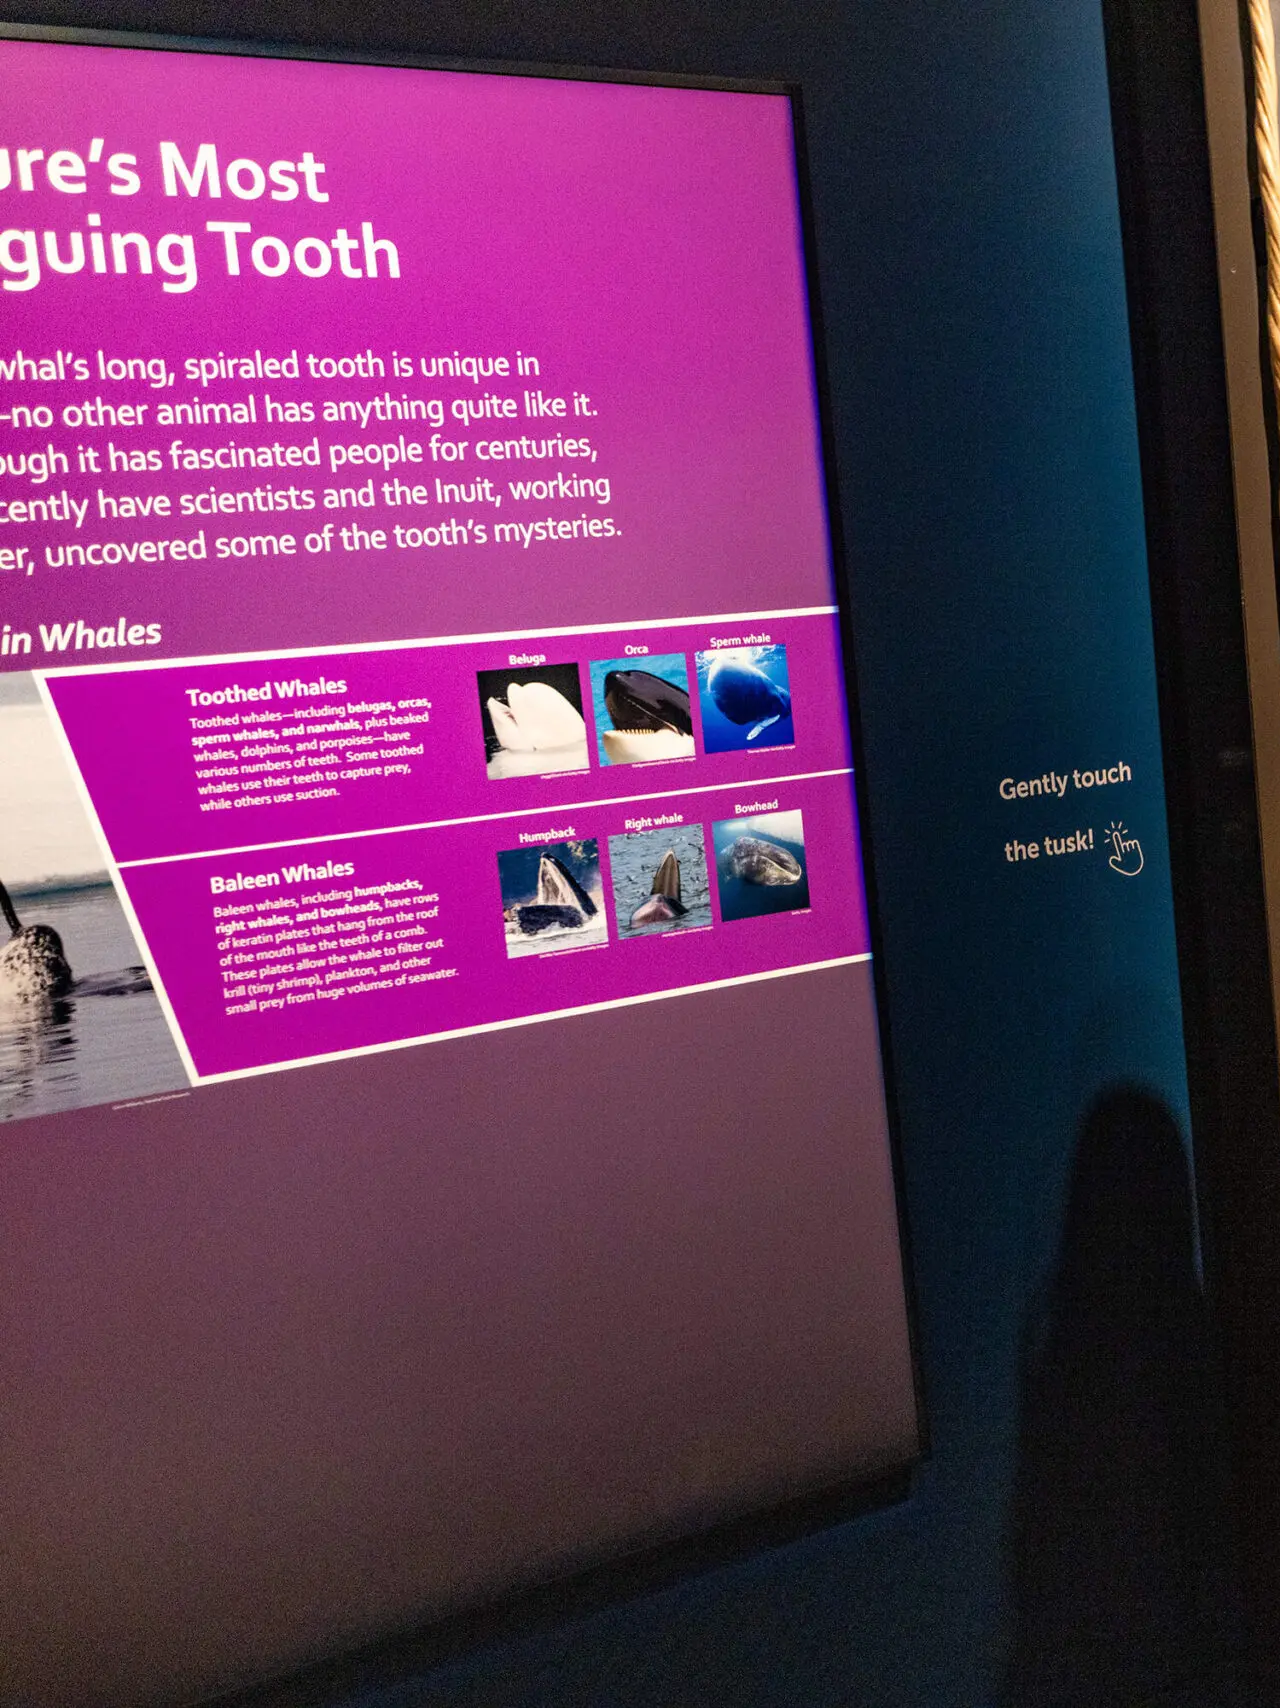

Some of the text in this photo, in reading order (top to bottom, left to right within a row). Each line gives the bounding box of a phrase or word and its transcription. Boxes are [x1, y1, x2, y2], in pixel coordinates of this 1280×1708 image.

[160, 142, 329, 202] Most
[0, 214, 400, 293] guing Tooth
[98, 350, 174, 388] long,
[185, 350, 299, 387] spiraled
[306, 350, 384, 378] tooth
[393, 352, 413, 377] is
[421, 351, 509, 384] unique
[517, 351, 539, 375] in
[63, 397, 148, 426] other
[158, 395, 256, 425] animal
[265, 395, 315, 422] has
[323, 393, 444, 428] anything
[452, 393, 517, 426] quite
[524, 391, 566, 416] like
[574, 392, 597, 416] it.
[78, 445, 101, 472] it
[109, 443, 162, 471] has
[169, 437, 320, 469] fascinated
[330, 435, 422, 472] people
[429, 434, 468, 461] for
[476, 433, 597, 462] centuries,
[98, 489, 170, 518] have
[180, 485, 315, 514] scientists
[324, 479, 375, 508] and
[382, 478, 427, 505] the
[436, 477, 501, 507] Inuit,
[509, 472, 610, 504] working
[46, 531, 206, 567] uncovered
[216, 535, 296, 558] some
[305, 524, 333, 552] of
[339, 523, 387, 551] the
[393, 519, 487, 548] tooth's
[494, 514, 621, 548] mysteries.
[2, 618, 161, 655] in Whales
[625, 645, 648, 655] Orca
[710, 632, 771, 648] Sperm whale
[509, 654, 545, 666] Beluga
[186, 677, 347, 706] Toothed Whales
[189, 714, 239, 728] Toothed
[347, 701, 396, 714] belugas,
[398, 698, 431, 714] orcas,
[192, 712, 428, 748] sperm whales, and narwhals, plus beaked
[194, 749, 238, 761] whales,
[241, 744, 293, 758] dolphins,
[296, 739, 317, 751] and
[196, 744, 423, 778] various numbers of teeth. Some toothed
[198, 764, 411, 794] whales use their teeth to capture prey,
[999, 761, 1132, 800] Gently touch
[200, 788, 339, 811] while others use suction.
[735, 800, 778, 814] Bowhead
[519, 827, 575, 843] Humpback
[625, 812, 684, 831] Right whale
[1004, 828, 1094, 862] the tusk!
[211, 861, 354, 893] Baleen Whales
[214, 878, 423, 917] Baleen whales, including humpbacks,
[216, 892, 439, 935] right whales, and bowheads, have rows
[232, 906, 439, 947] keratin plates that hang from roof
[256, 926, 428, 960] mouth teeth comb.
[221, 939, 444, 982] These plates allow whale filter out
[224, 956, 431, 998] krill (tiny shrimp), plankton, and other
[226, 969, 458, 1015] small prey from huge volumes seawater.
